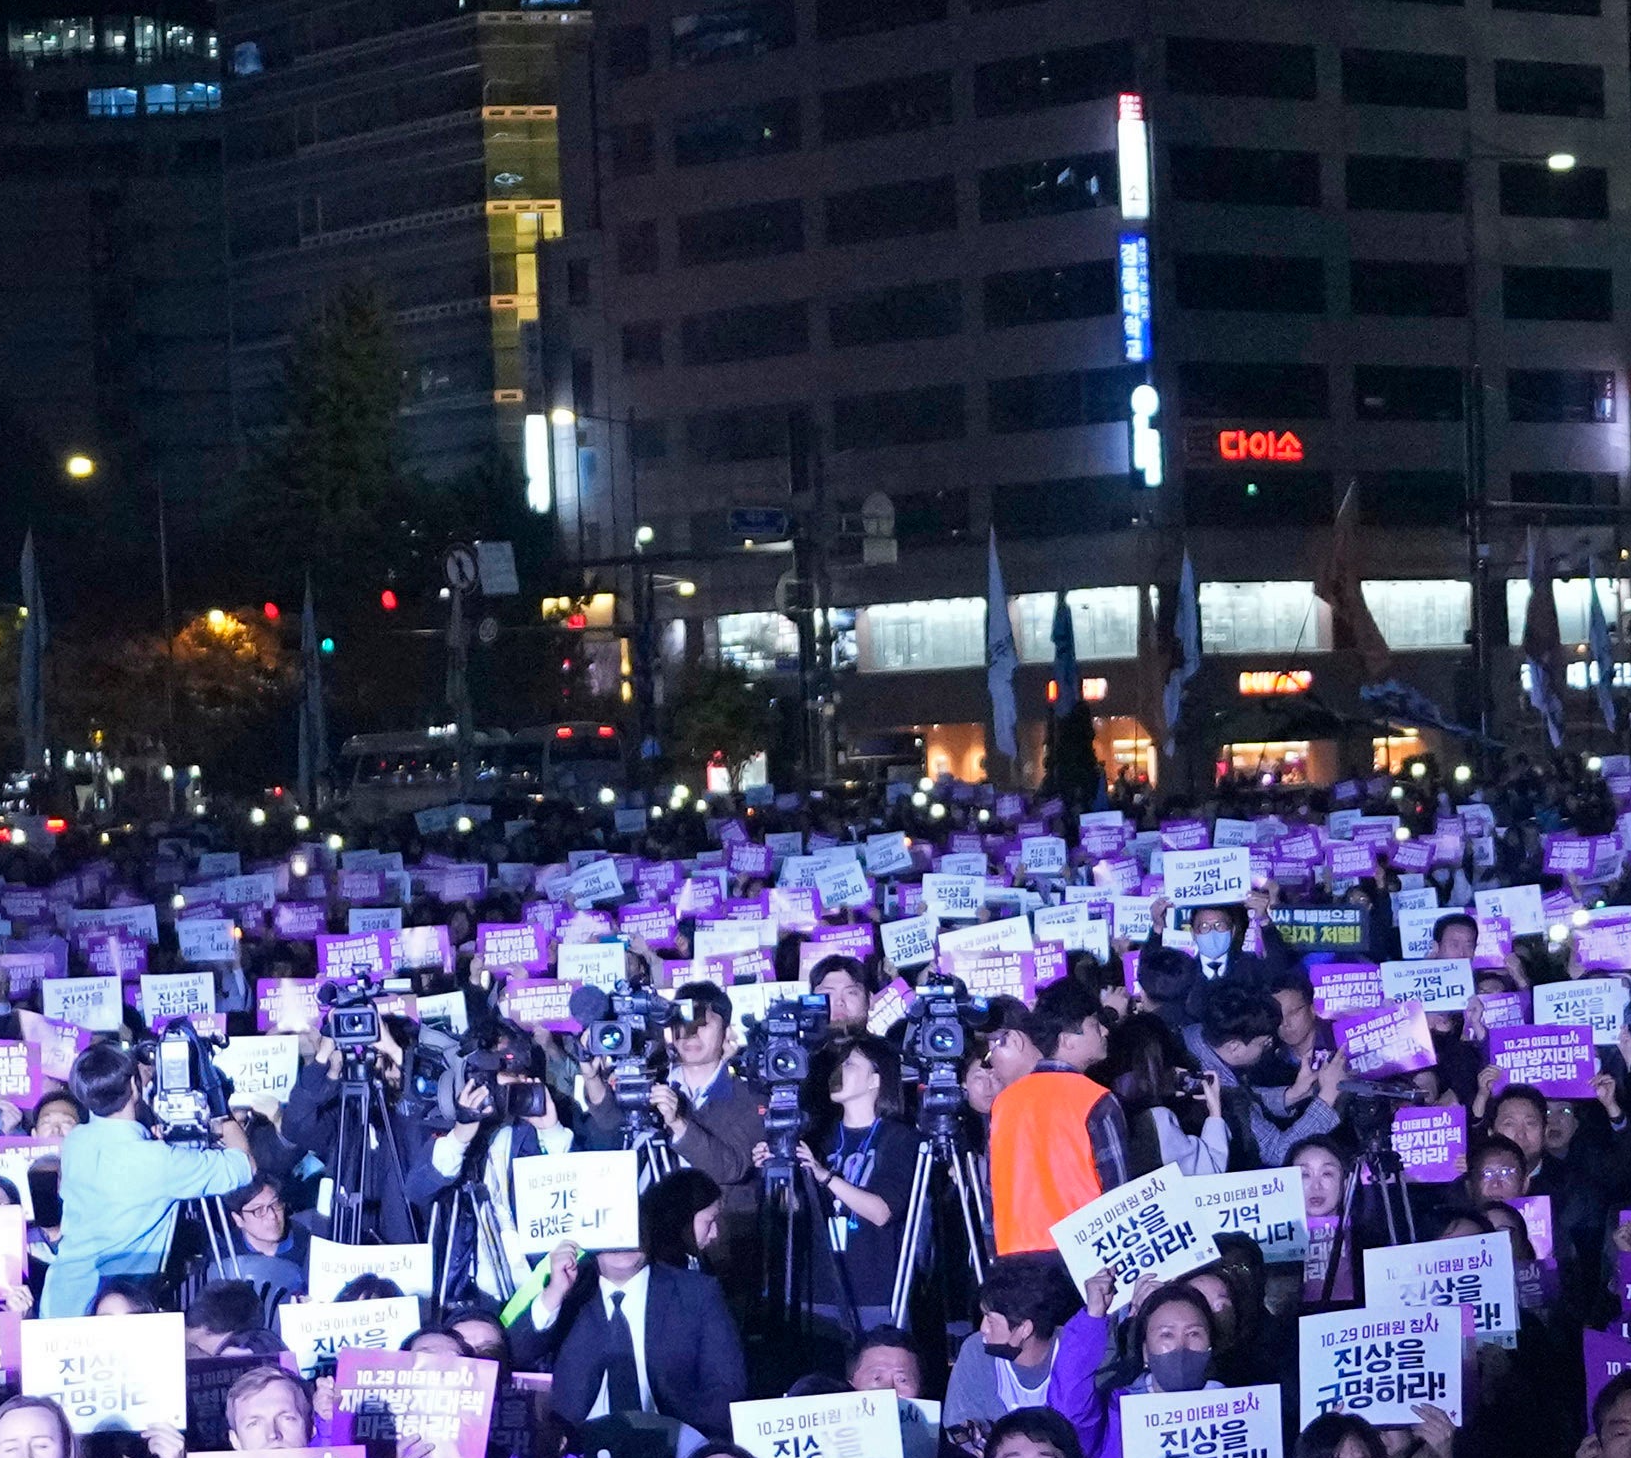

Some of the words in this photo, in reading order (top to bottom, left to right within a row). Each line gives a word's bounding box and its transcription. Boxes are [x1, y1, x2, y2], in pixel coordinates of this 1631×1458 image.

[1218, 429, 1305, 462] 다이소
[1193, 867, 1221, 884] 기억
[1174, 878, 1242, 900] 하겠습니다
[1321, 925, 1361, 944] 처벌!
[1414, 975, 1442, 990] 기억
[1395, 984, 1466, 1004] 하겠습니다
[1504, 1041, 1528, 1052] 10.29
[1496, 1047, 1589, 1070] 재발방지대책
[1508, 1065, 1578, 1082] 마련하라!
[1218, 1204, 1262, 1231] 기억
[1093, 1201, 1169, 1262] 진상을
[1334, 1341, 1426, 1378] 진상을
[1143, 1411, 1184, 1428] 10.29
[1160, 1421, 1248, 1458] 진상을
